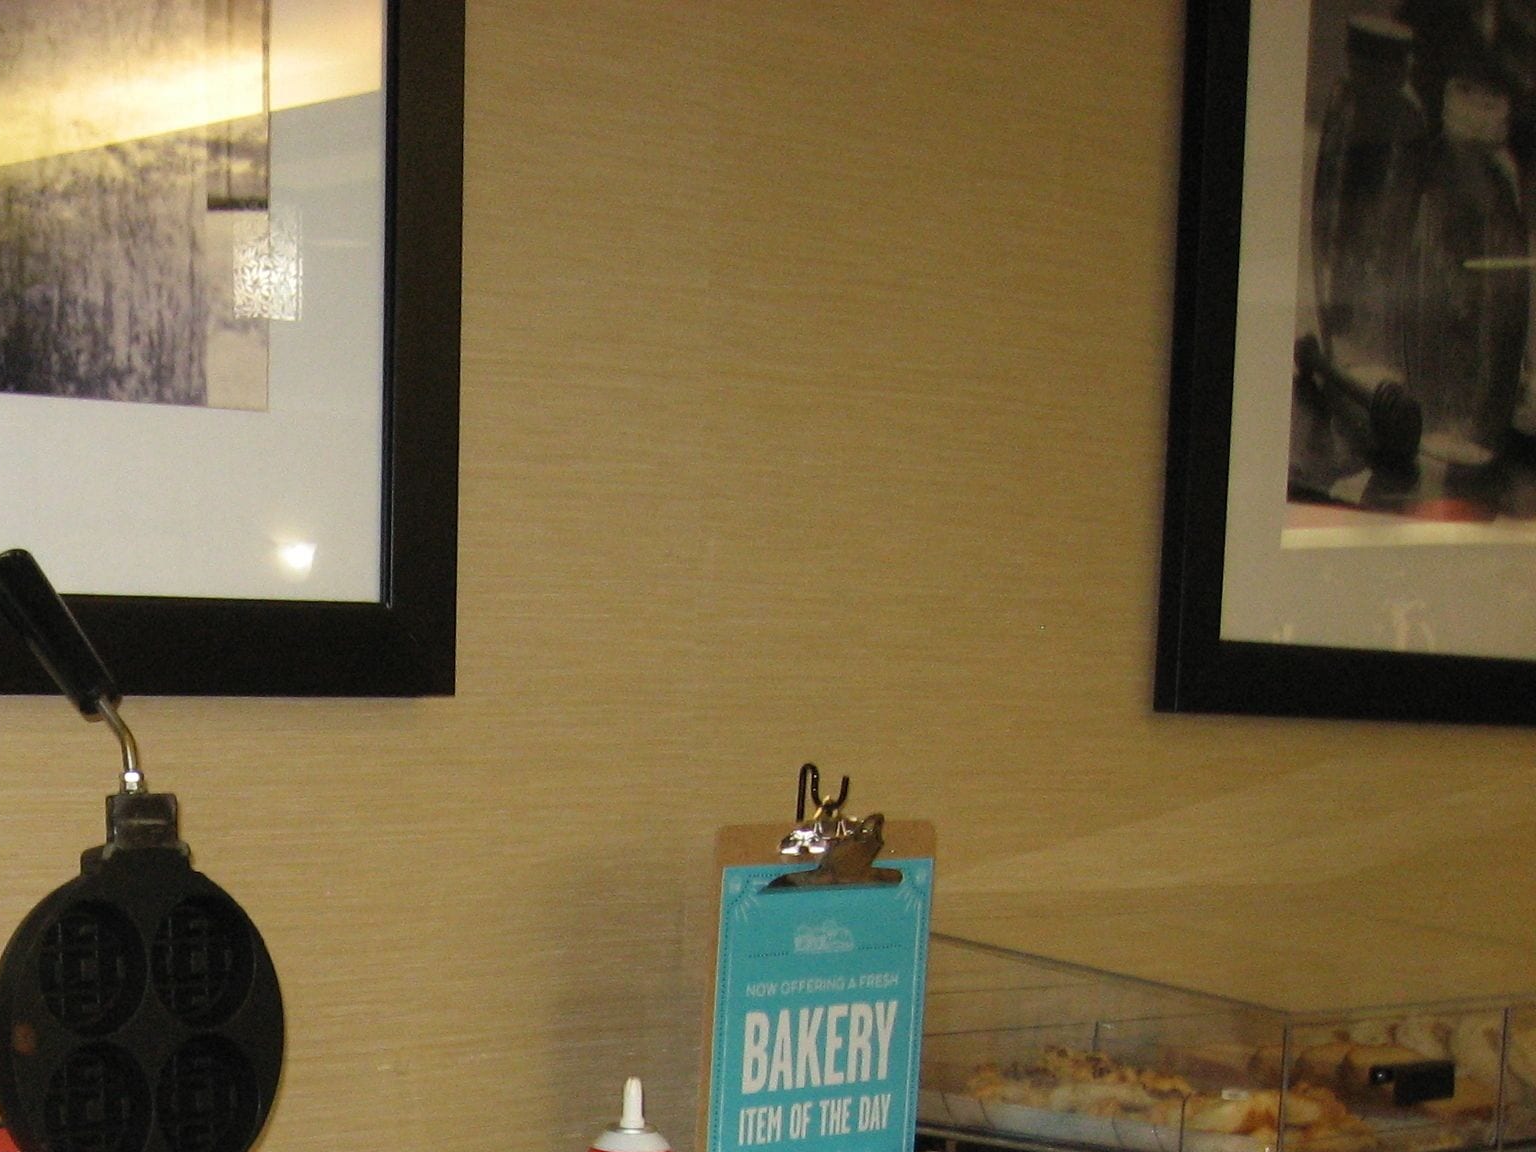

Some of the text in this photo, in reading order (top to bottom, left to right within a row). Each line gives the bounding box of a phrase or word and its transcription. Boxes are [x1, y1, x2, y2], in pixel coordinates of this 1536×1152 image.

[745, 972, 899, 997] NOW OFFERING A FRESH
[741, 1000, 898, 1095] BAKERY
[738, 1093, 891, 1146] ITEM OF THE DAY
